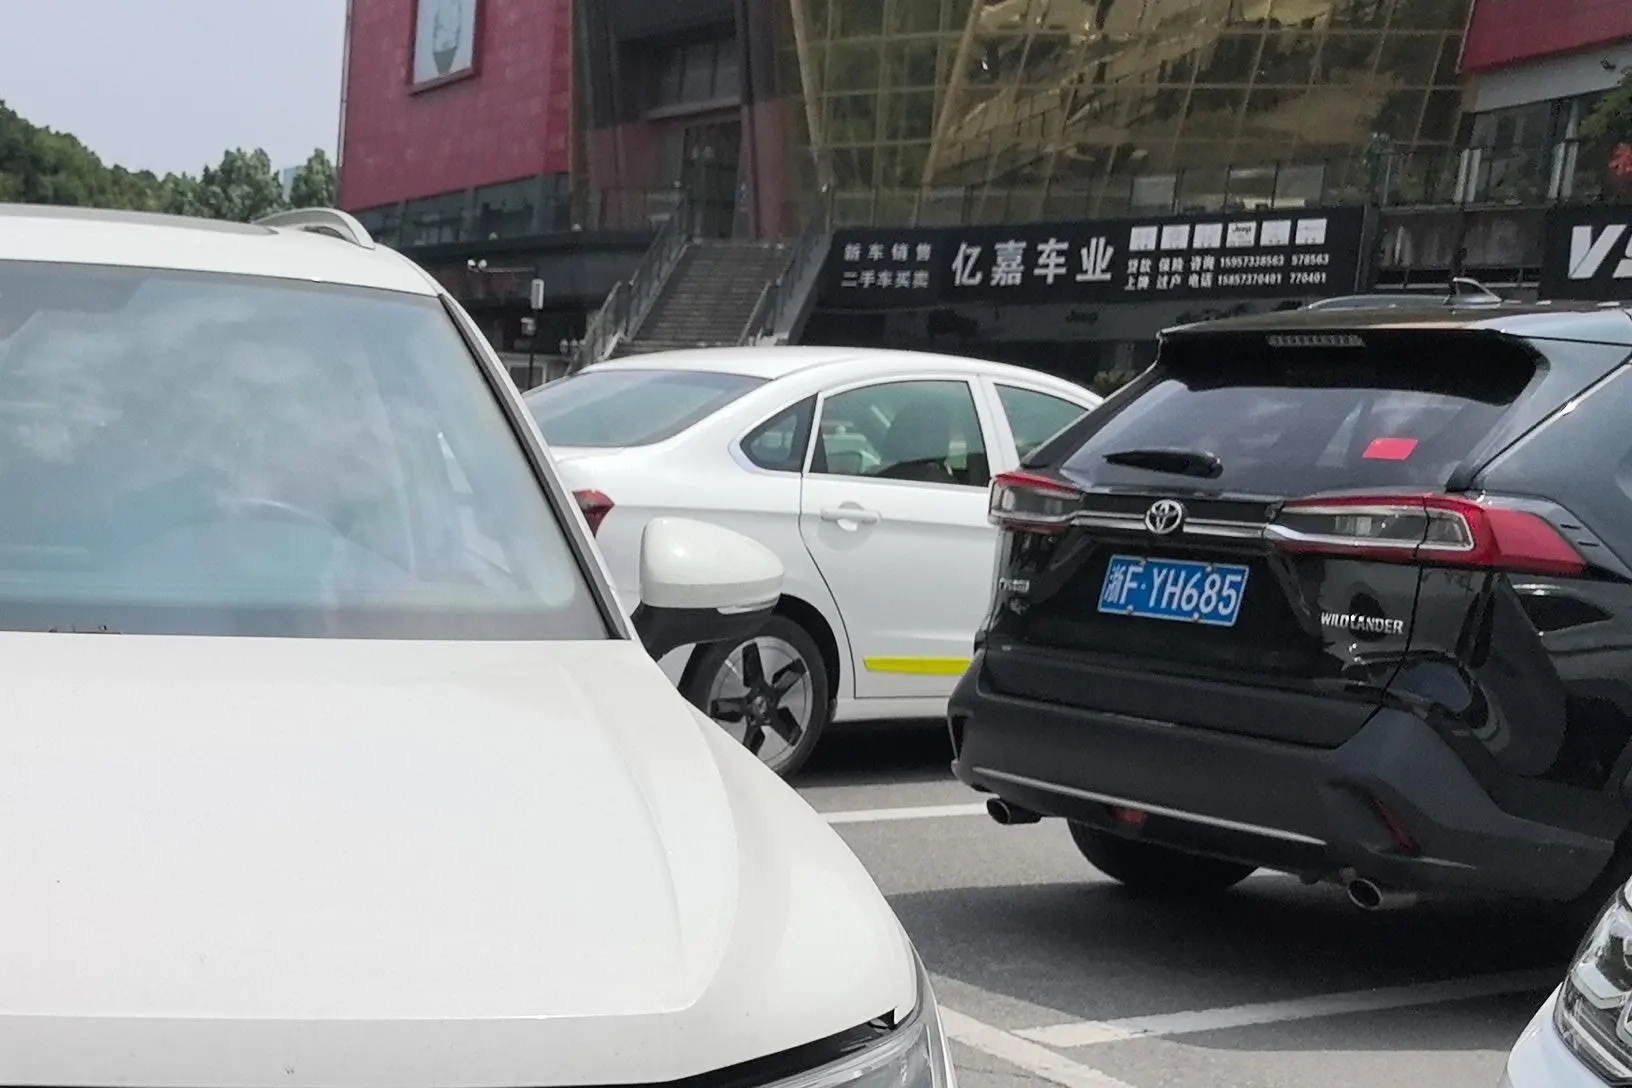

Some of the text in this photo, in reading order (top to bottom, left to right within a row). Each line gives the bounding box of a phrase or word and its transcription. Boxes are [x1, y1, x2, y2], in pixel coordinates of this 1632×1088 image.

[843, 242, 932, 262] 新车销售
[951, 236, 1114, 286] 亿嘉车业
[841, 270, 930, 288] 二手车买卖
[1321, 611, 1404, 635] WILDLANDER
